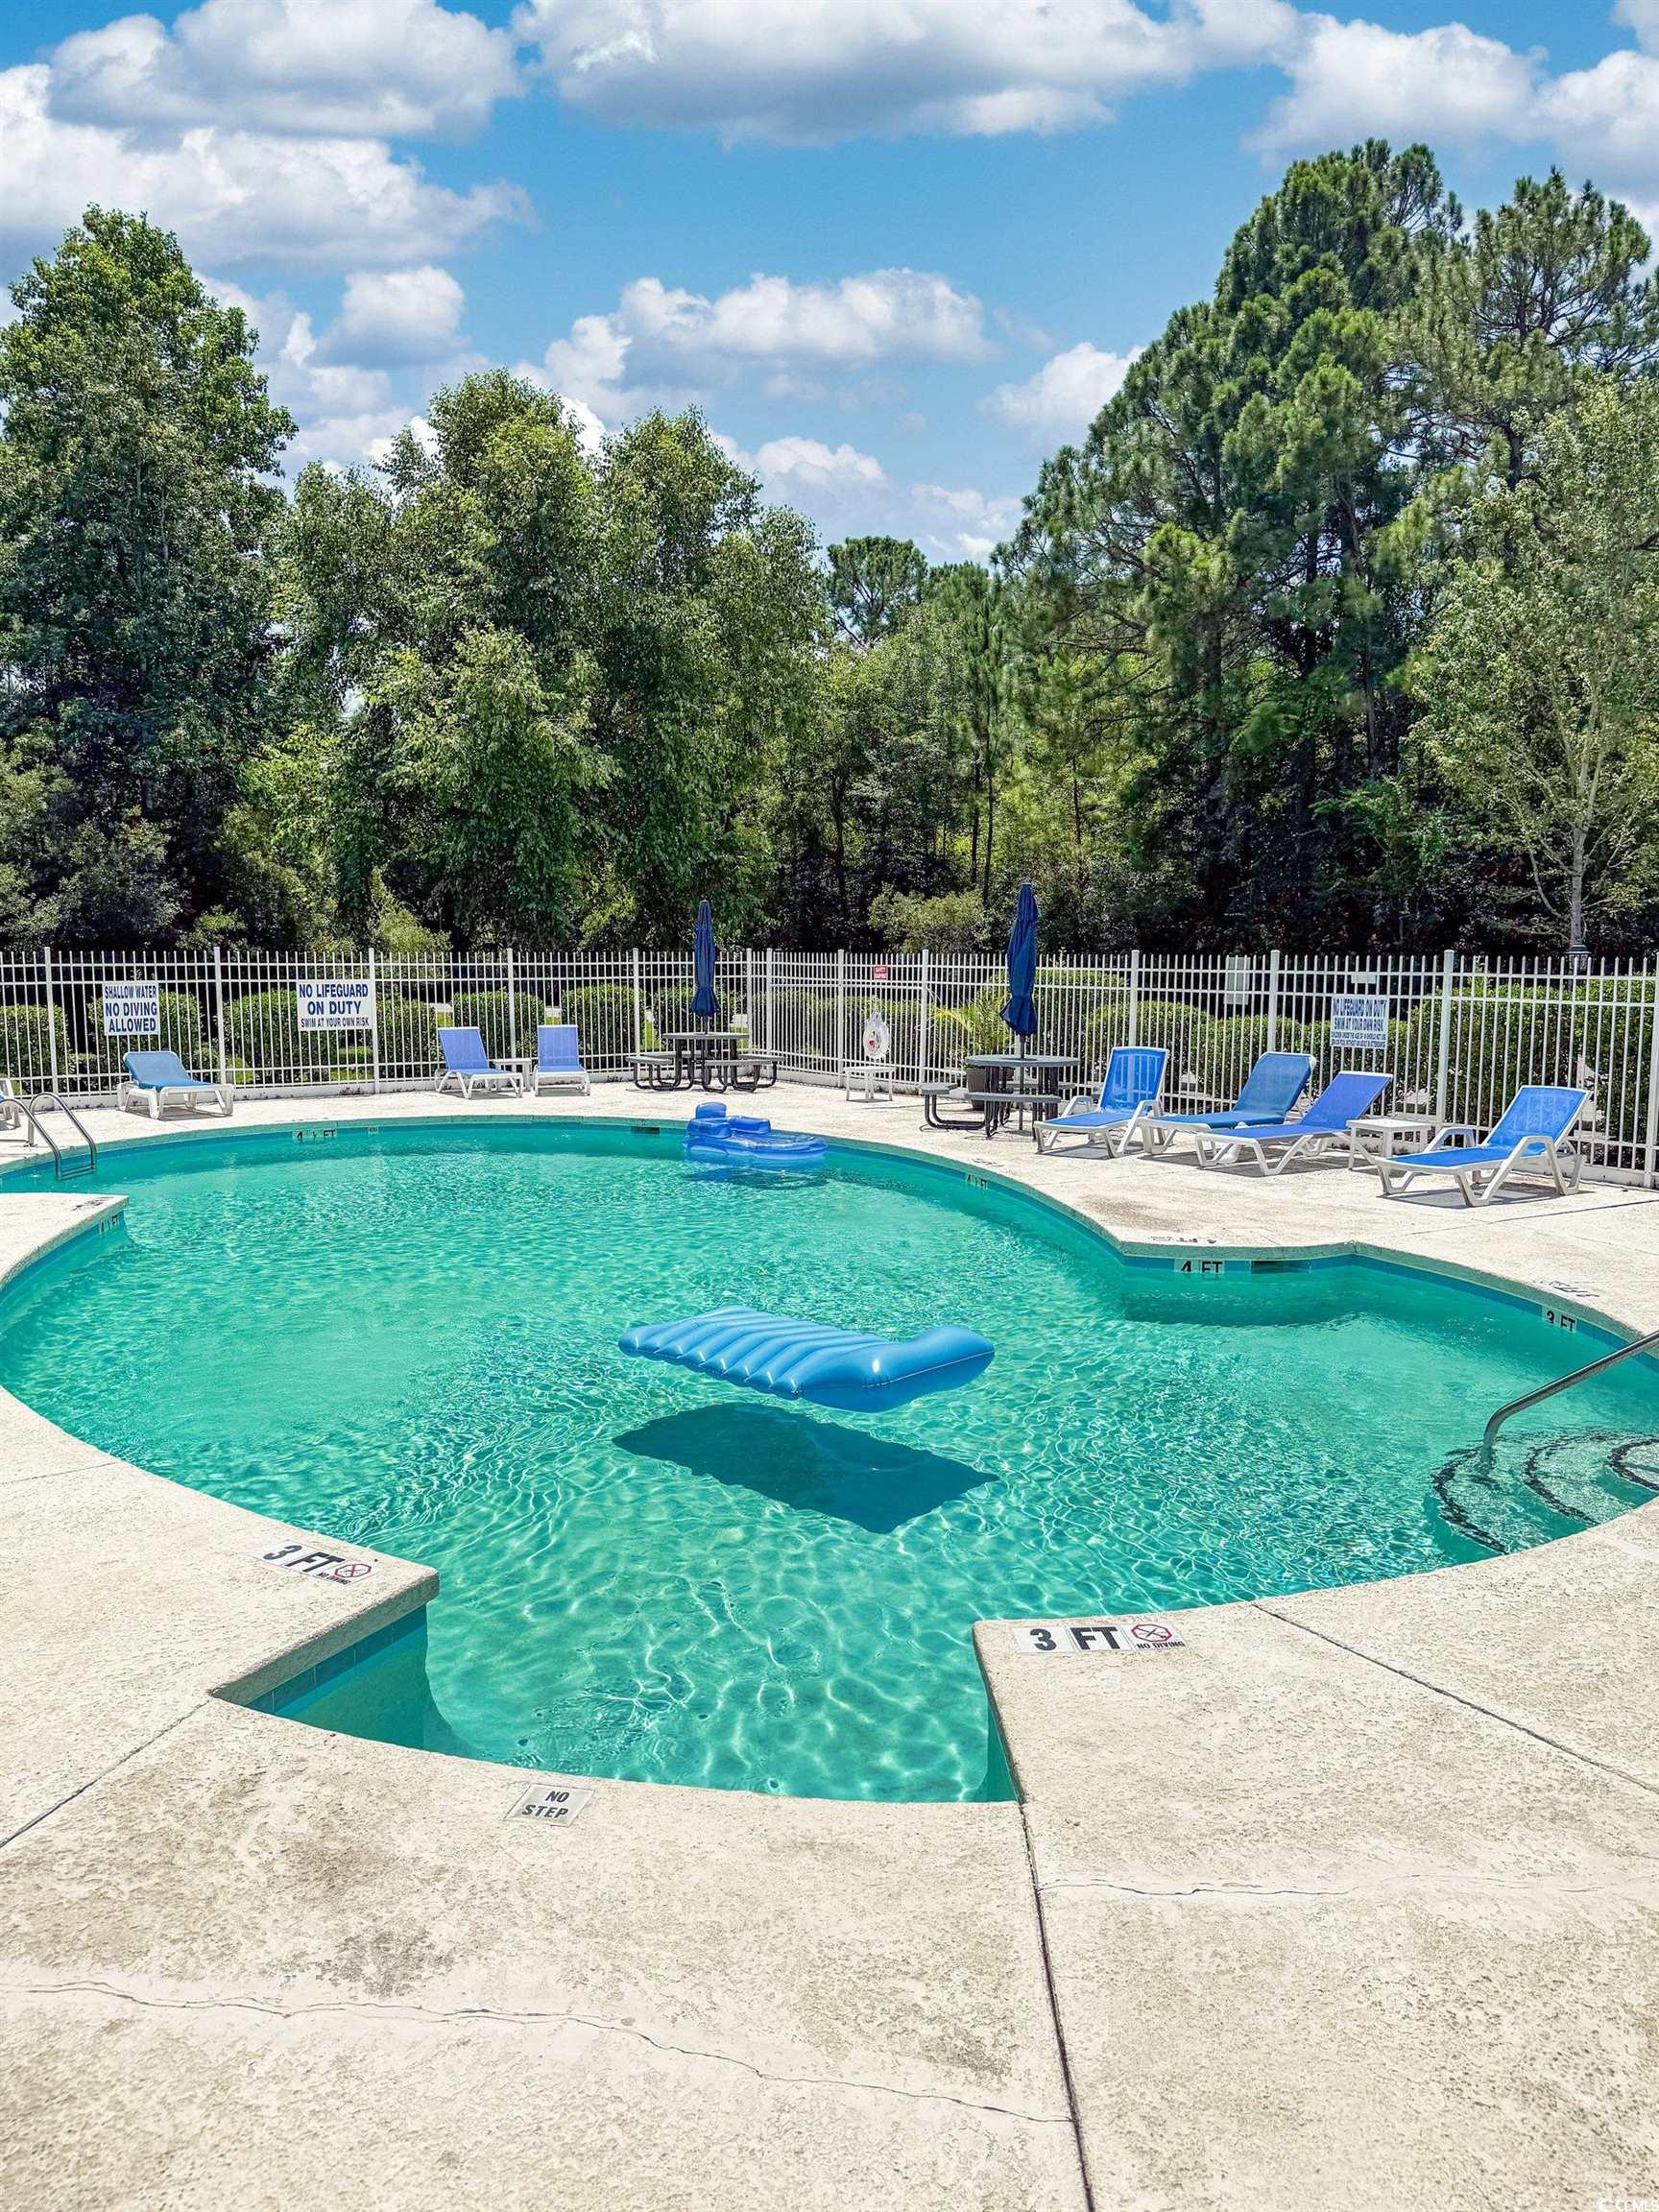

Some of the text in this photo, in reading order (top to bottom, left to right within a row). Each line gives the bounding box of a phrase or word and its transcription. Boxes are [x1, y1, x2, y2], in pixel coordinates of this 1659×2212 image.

[105, 985, 156, 998] SHALLOW WATER
[299, 983, 369, 998] NO LIFEGUARD
[106, 1001, 157, 1017] NO DIVING
[307, 1000, 361, 1015] ON DUTY
[108, 1018, 156, 1032] ALLOWED
[301, 1017, 370, 1027] SWIM AT YOUR OWN RISK
[1201, 1261, 1223, 1273] FT
[1560, 1314, 1575, 1332] FT
[262, 1544, 347, 1573] 3 FT
[1029, 1626, 1121, 1651] 3 FT
[1152, 1641, 1186, 1649] DIVING
[544, 1791, 570, 1803] NO
[521, 1804, 569, 1818] STEP
